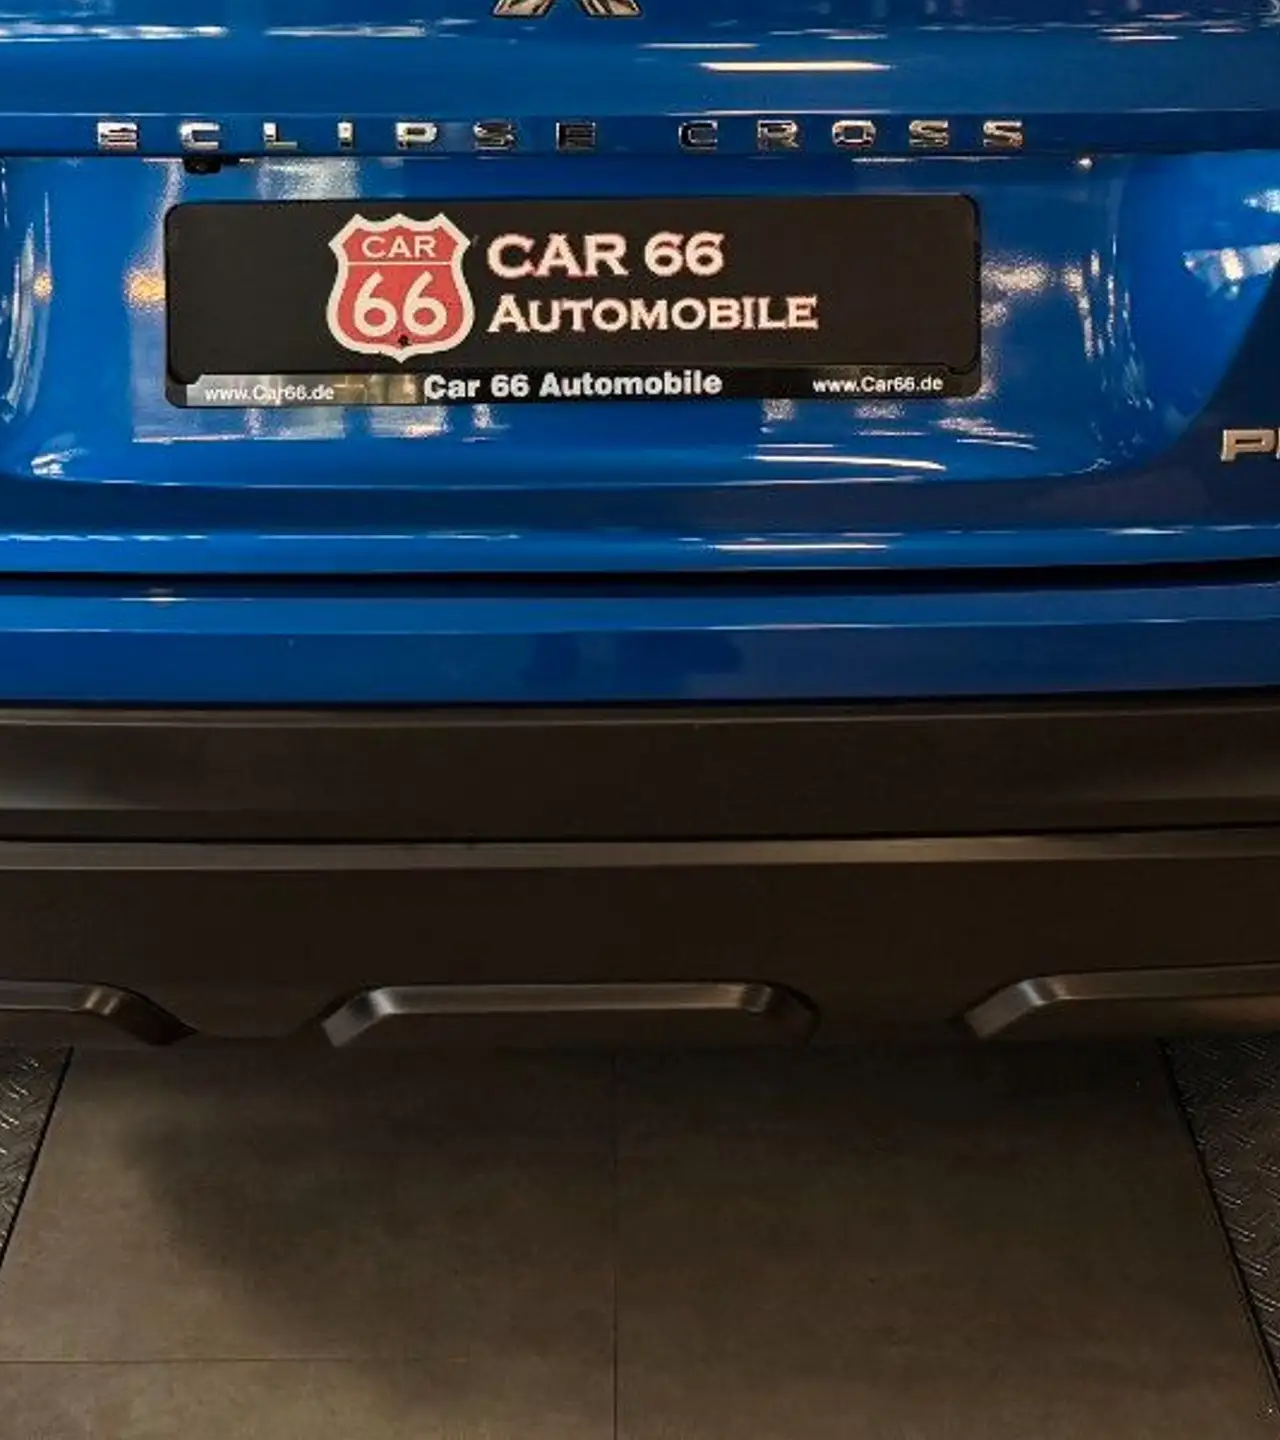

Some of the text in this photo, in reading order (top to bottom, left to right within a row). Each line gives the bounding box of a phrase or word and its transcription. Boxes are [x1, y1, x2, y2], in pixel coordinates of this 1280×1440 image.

[97, 120, 1023, 150] ECLIPSE CROSS
[361, 235, 436, 259] CAR
[487, 232, 724, 278] CAR 66
[352, 271, 447, 337] 66
[487, 294, 818, 333] AUTOMOBILE
[204, 384, 335, 401] www.Car66.de
[424, 369, 723, 399] Car 66 Automobile
[813, 376, 943, 393] www.Car66.de
